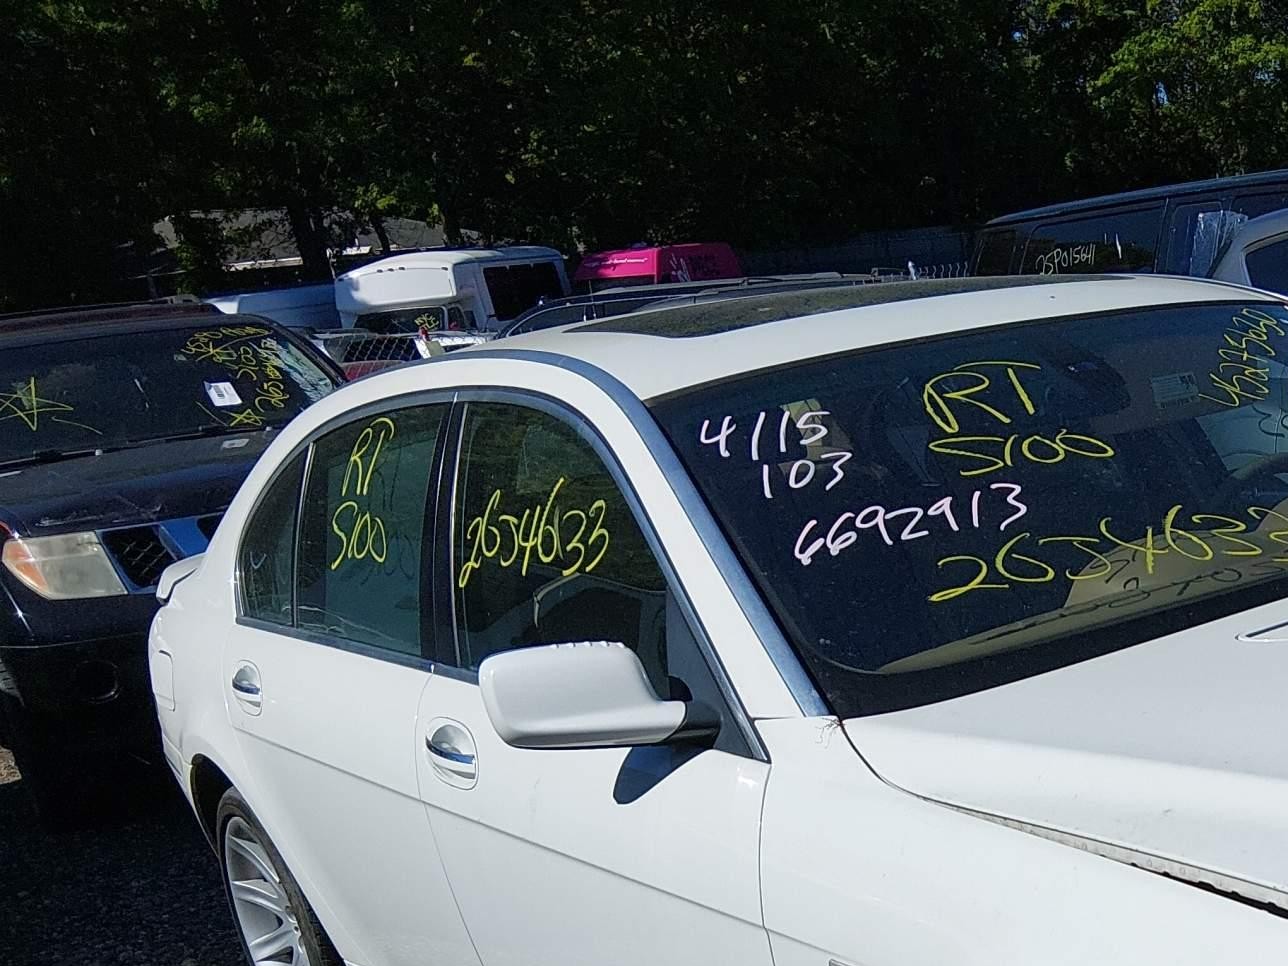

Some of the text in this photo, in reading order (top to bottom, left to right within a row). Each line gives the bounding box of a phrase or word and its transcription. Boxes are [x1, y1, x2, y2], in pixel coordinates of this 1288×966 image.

[922, 361, 1041, 434] RT
[762, 451, 854, 500] 103
[794, 482, 1029, 566] 6692913
